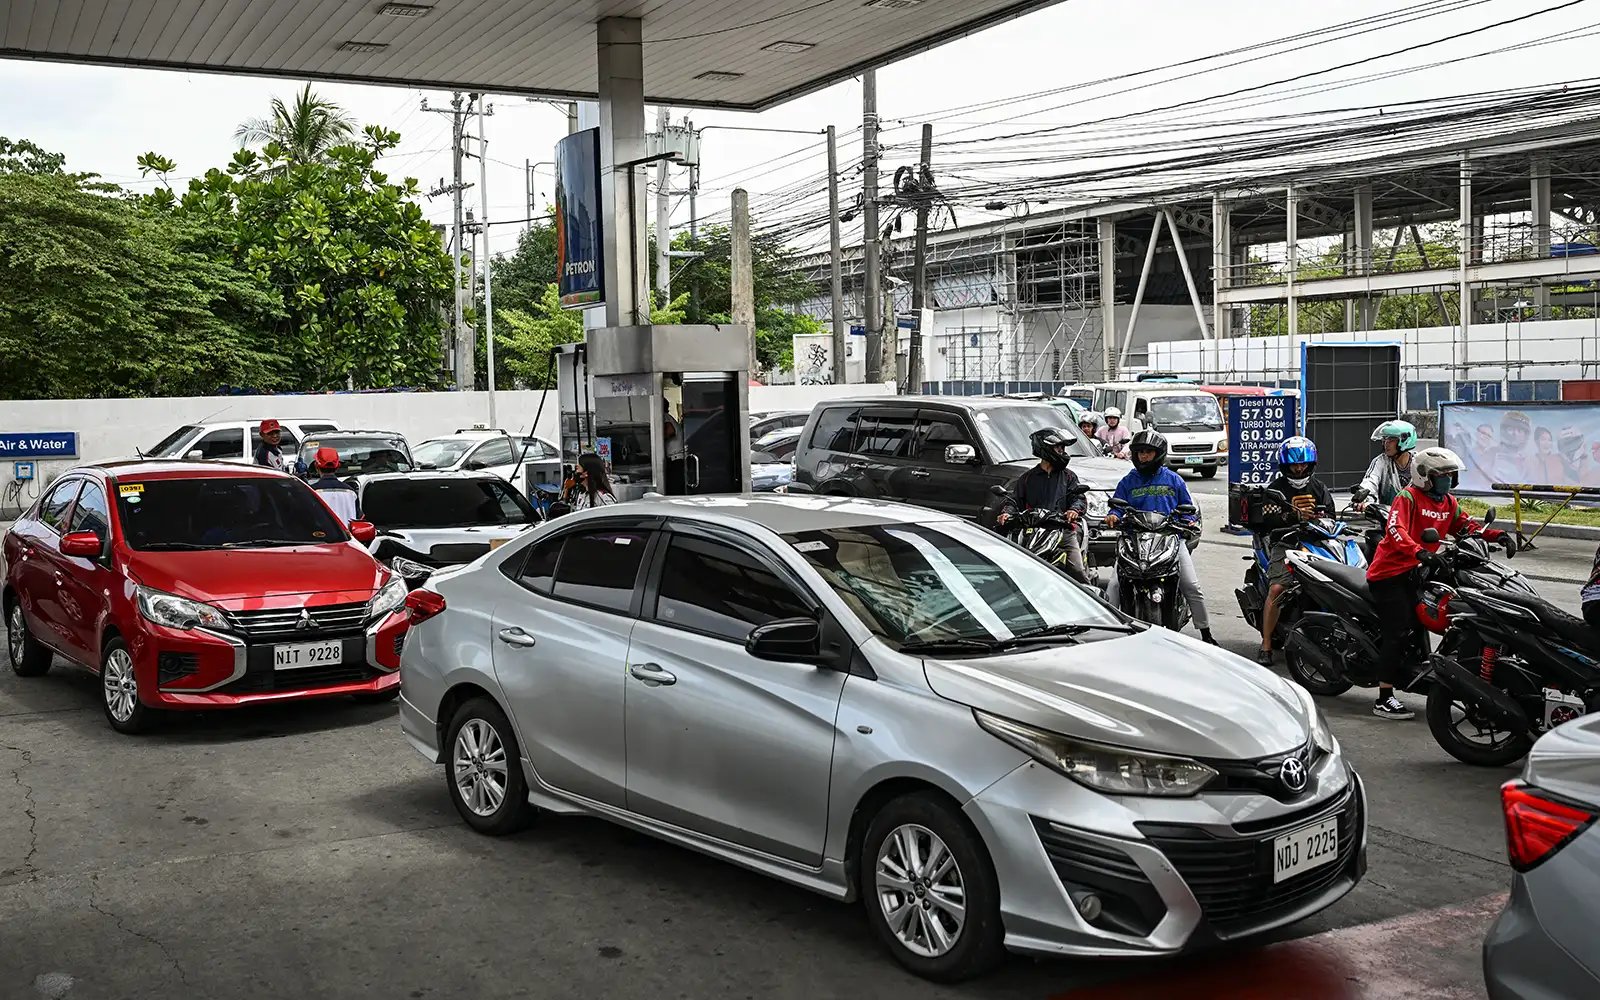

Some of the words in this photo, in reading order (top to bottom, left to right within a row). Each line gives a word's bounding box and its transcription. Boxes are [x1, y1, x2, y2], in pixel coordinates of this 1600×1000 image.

[565, 260, 595, 276] PETRON
[1240, 399, 1264, 407] Diesel
[1266, 399, 1284, 407] MAX
[1241, 408, 1283, 419] 57.90
[1240, 420, 1264, 428] TURBO
[1265, 420, 1285, 428] Diesel
[1241, 429, 1283, 441] 60.90
[0, 440, 16, 450] Air
[18, 440, 28, 449] &
[30, 440, 67, 449] Water
[1240, 442, 1258, 450] XTRA
[277, 650, 300, 664] NIT
[309, 646, 340, 661] 9228
[1277, 842, 1299, 872] NDJ
[1307, 828, 1336, 860] 2225
